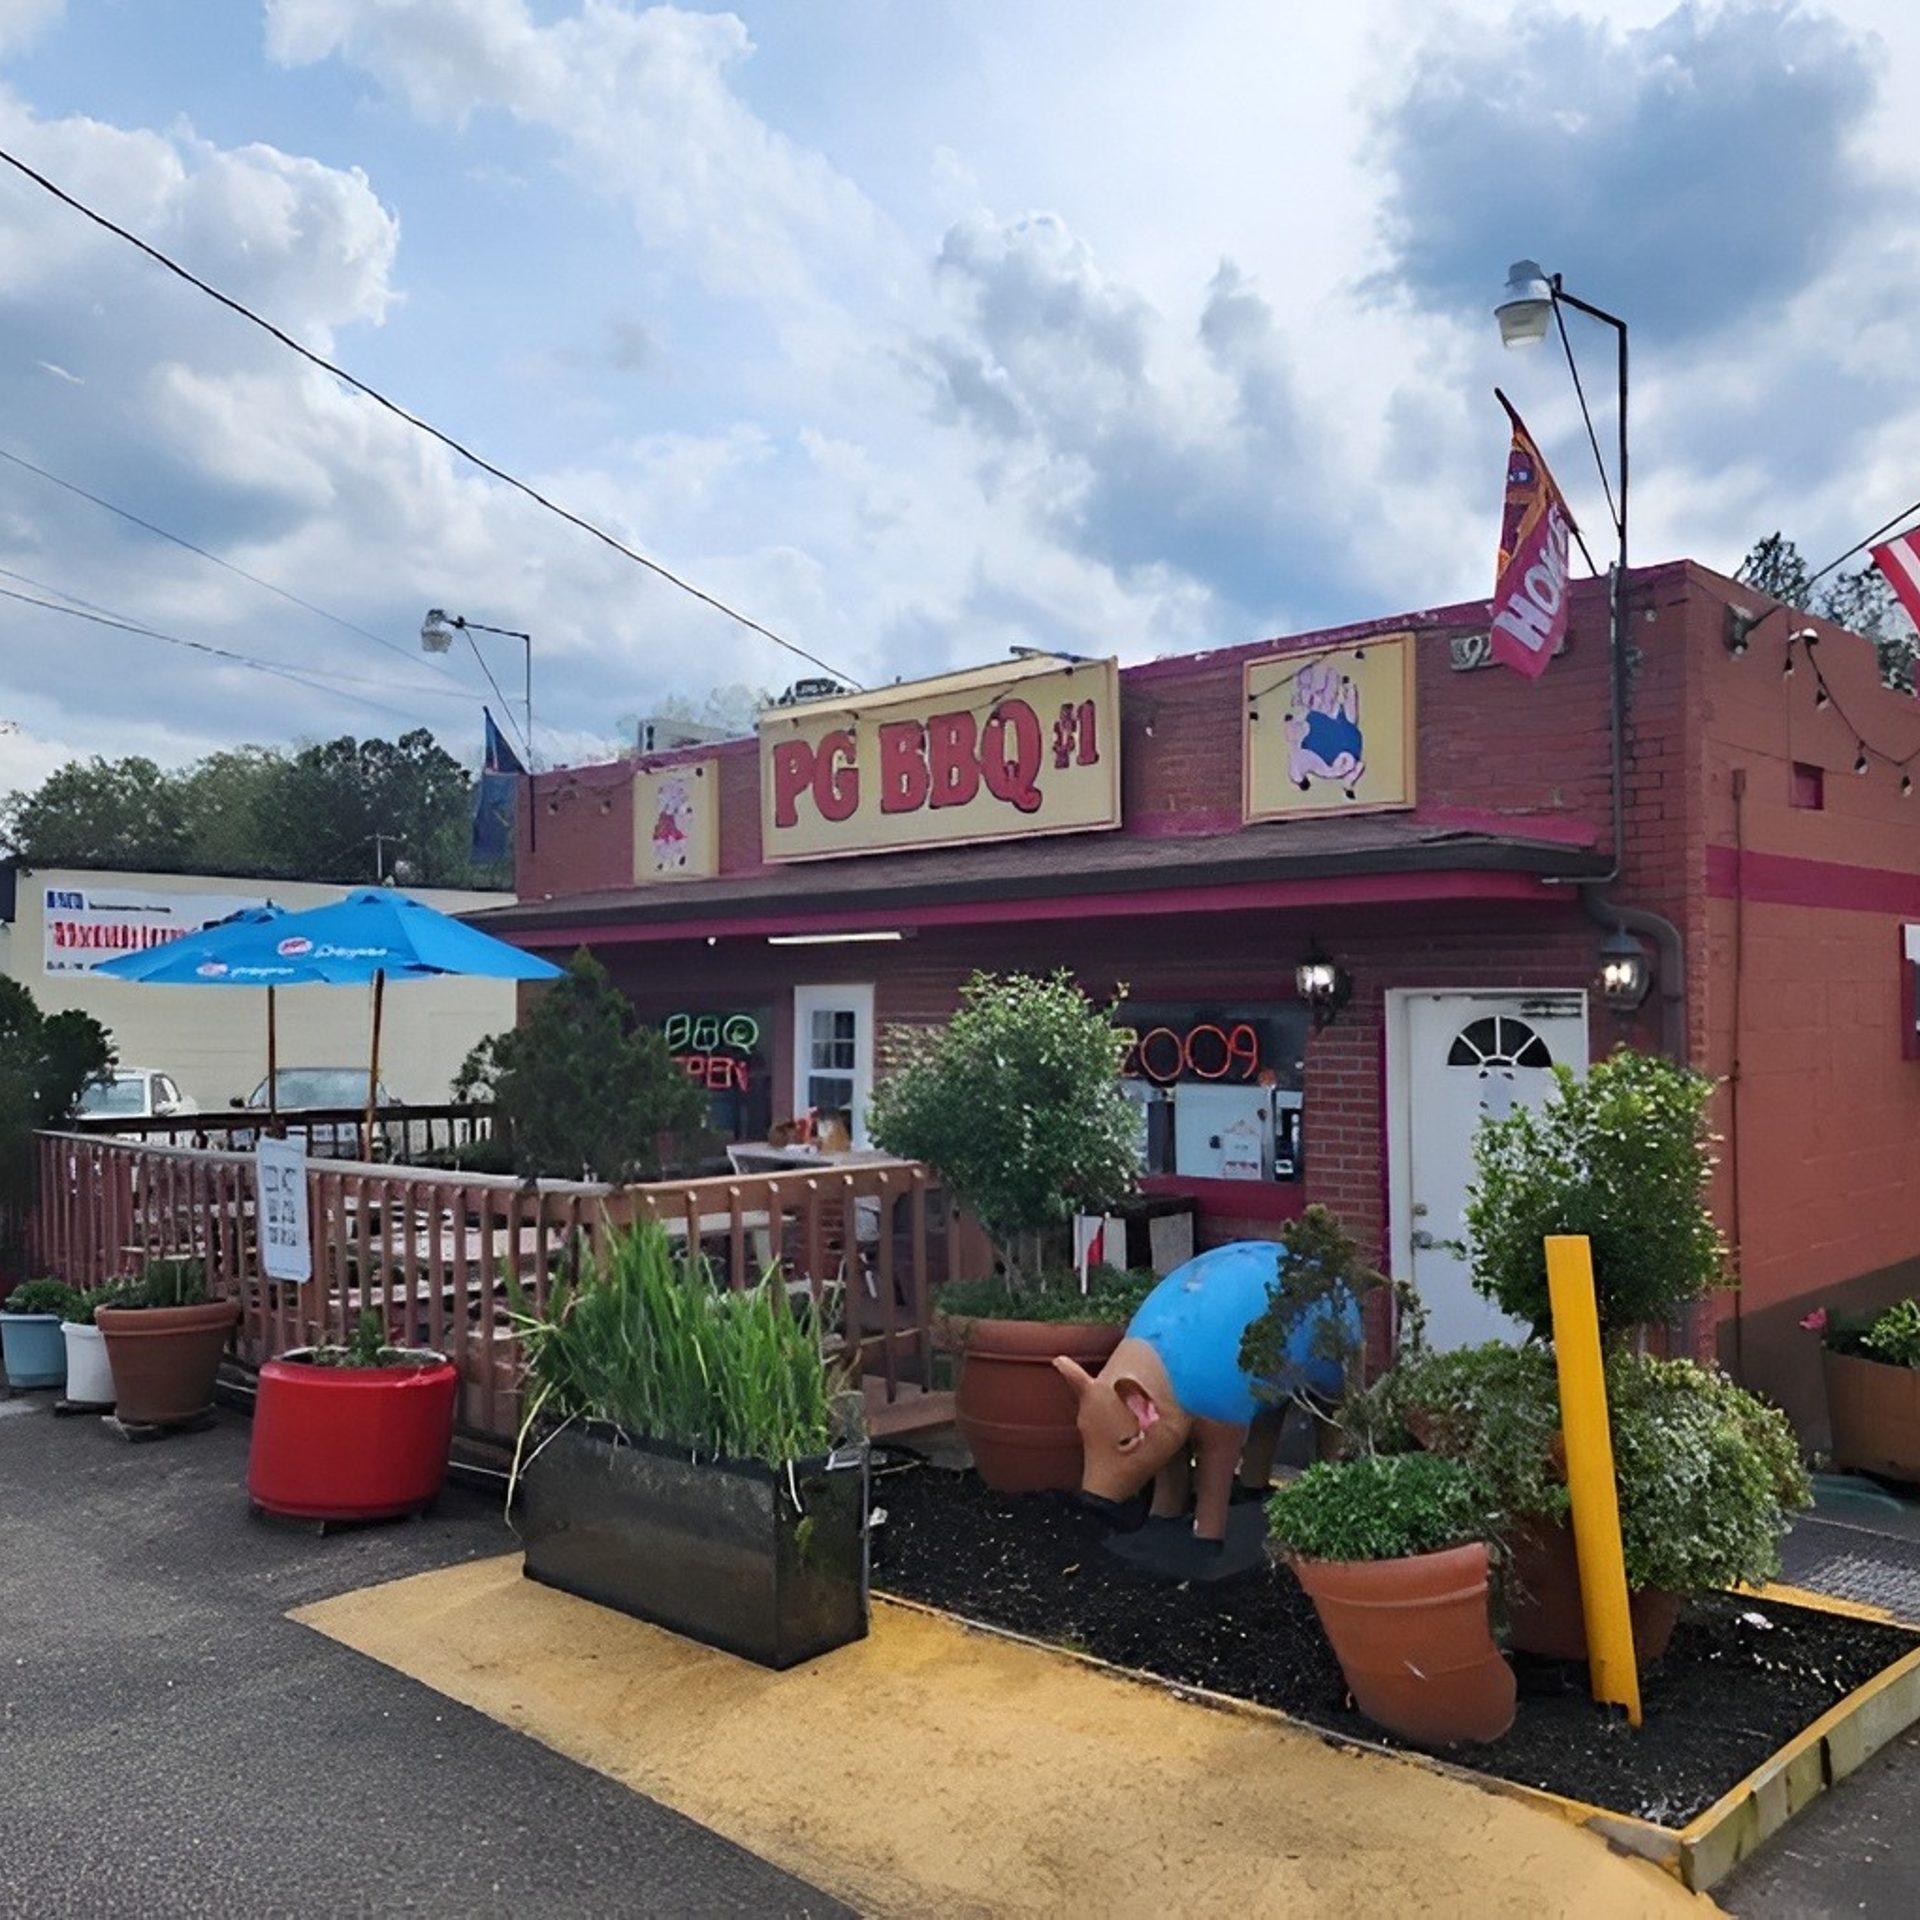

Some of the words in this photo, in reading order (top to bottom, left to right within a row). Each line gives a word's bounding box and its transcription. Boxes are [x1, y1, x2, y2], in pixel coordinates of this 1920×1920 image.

[773, 730, 859, 828] PG
[878, 698, 1043, 814] BBQ
[1052, 699, 1099, 769] #1
[669, 1055, 750, 1092] PEN
